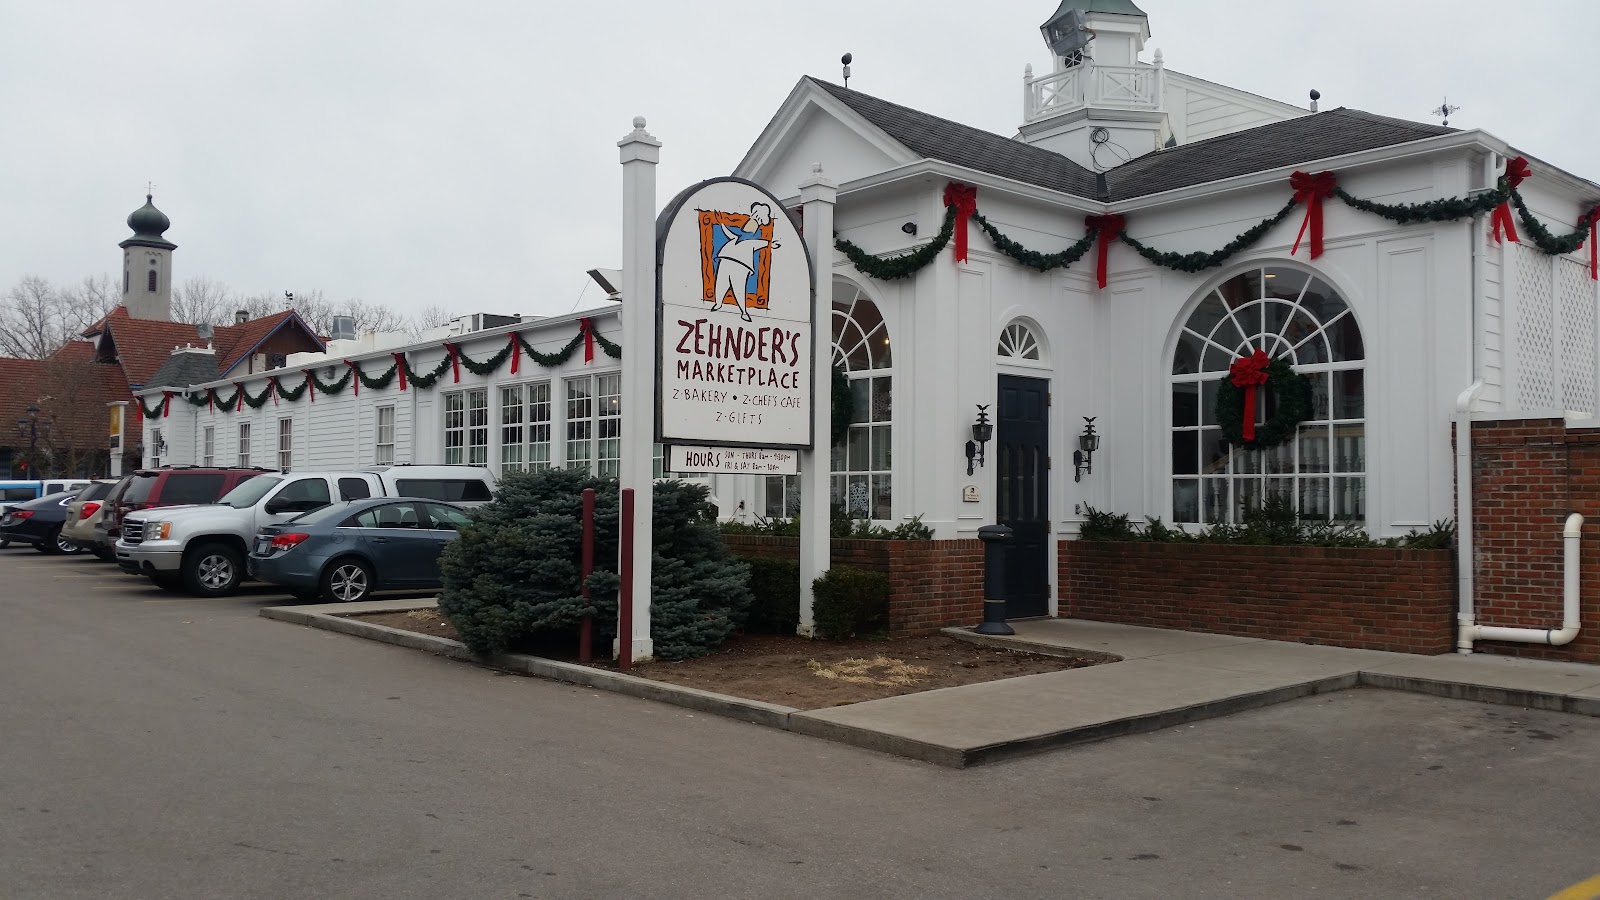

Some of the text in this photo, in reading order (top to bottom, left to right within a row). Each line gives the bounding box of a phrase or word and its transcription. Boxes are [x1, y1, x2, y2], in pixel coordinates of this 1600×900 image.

[676, 319, 800, 367] ZEHNDER'S
[677, 360, 799, 389] MARKETPLACE
[685, 451, 721, 467] HOURS
